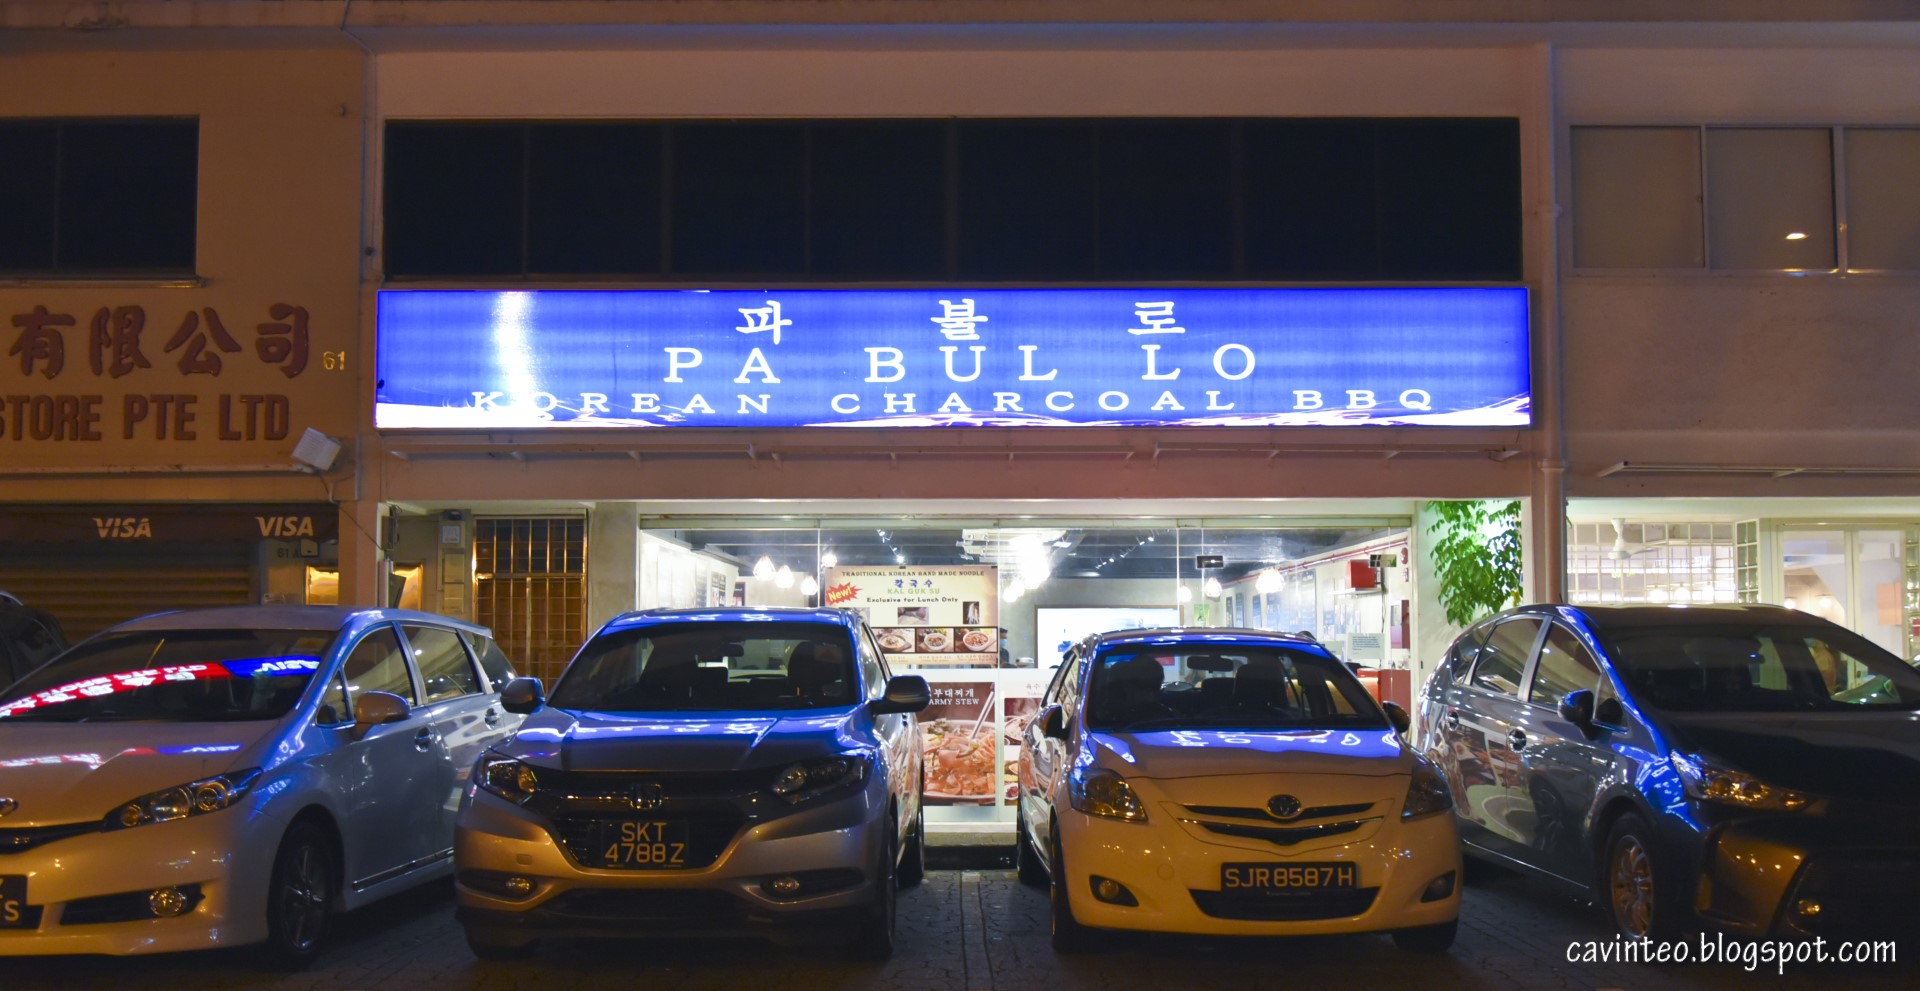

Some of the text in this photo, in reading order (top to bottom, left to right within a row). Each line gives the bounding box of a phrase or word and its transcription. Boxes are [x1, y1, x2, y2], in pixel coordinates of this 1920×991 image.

[736, 299, 1186, 344] 파 불 로
[8, 303, 310, 379] 有限公司
[322, 351, 346, 371] 61
[663, 343, 1256, 384] PA BUL LO
[471, 389, 1432, 415] KOREAN CHARCOAL BBQ
[0, 394, 290, 441] TORE PTE LTD
[93, 517, 152, 538] VISA
[254, 516, 314, 537] VISA
[827, 586, 852, 602] New!
[928, 698, 953, 706] ARMY
[933, 688, 974, 698] 부대찌개
[621, 822, 668, 842] SKT
[604, 843, 685, 863] 4788Z
[1225, 867, 1352, 888] SJR8587H
